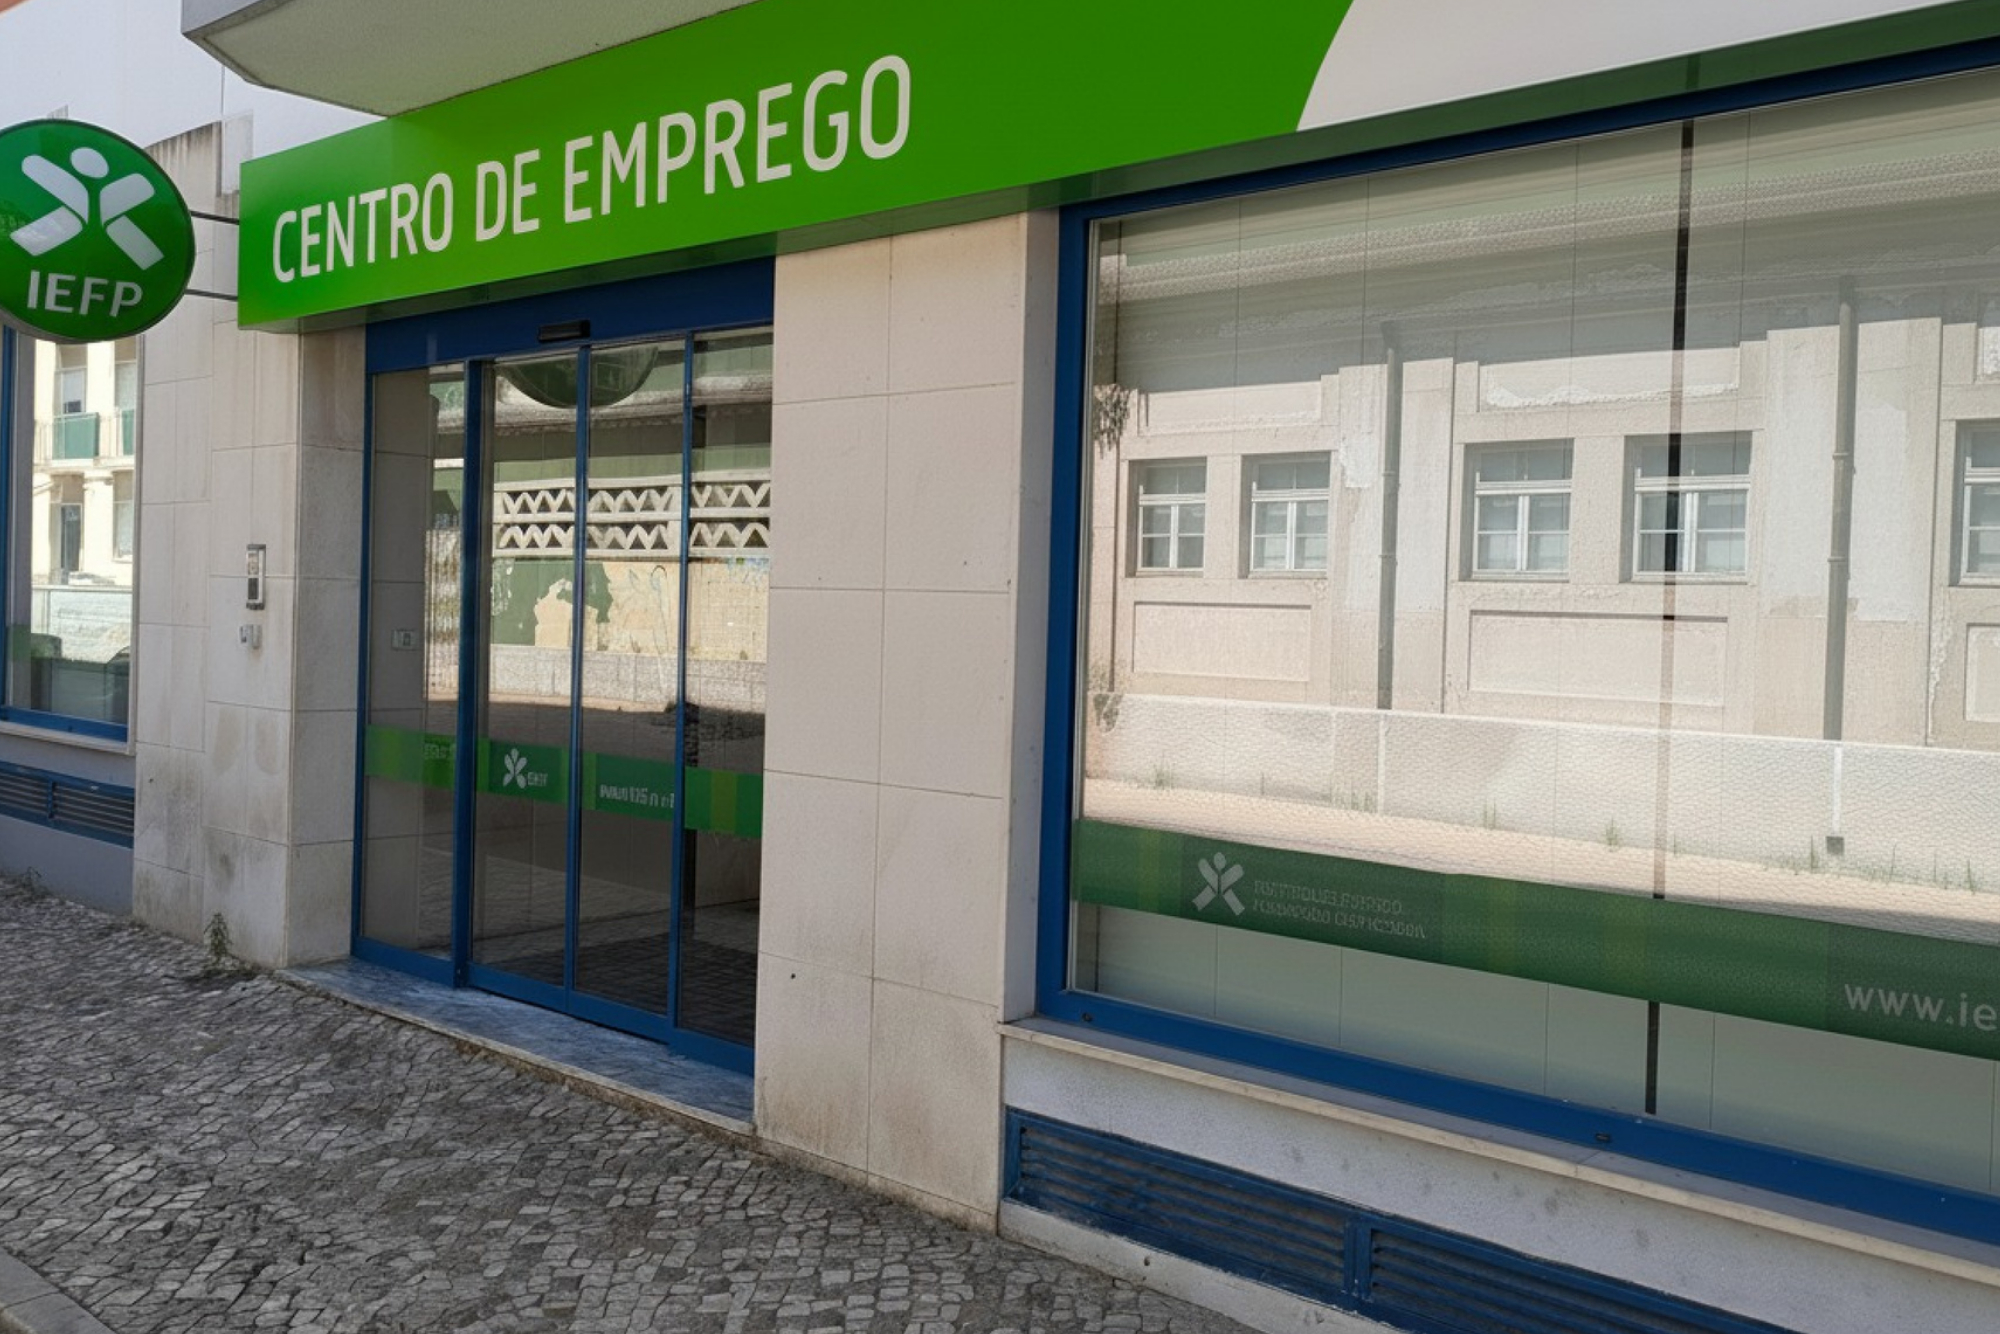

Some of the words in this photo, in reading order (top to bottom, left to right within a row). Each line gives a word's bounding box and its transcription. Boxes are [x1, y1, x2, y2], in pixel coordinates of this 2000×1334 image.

[272, 172, 454, 283] CENTRO
[475, 148, 541, 242] DE
[563, 54, 912, 224] EMPREGO
[26, 269, 144, 318] IEFP
[1843, 983, 1998, 1032] www.ie
